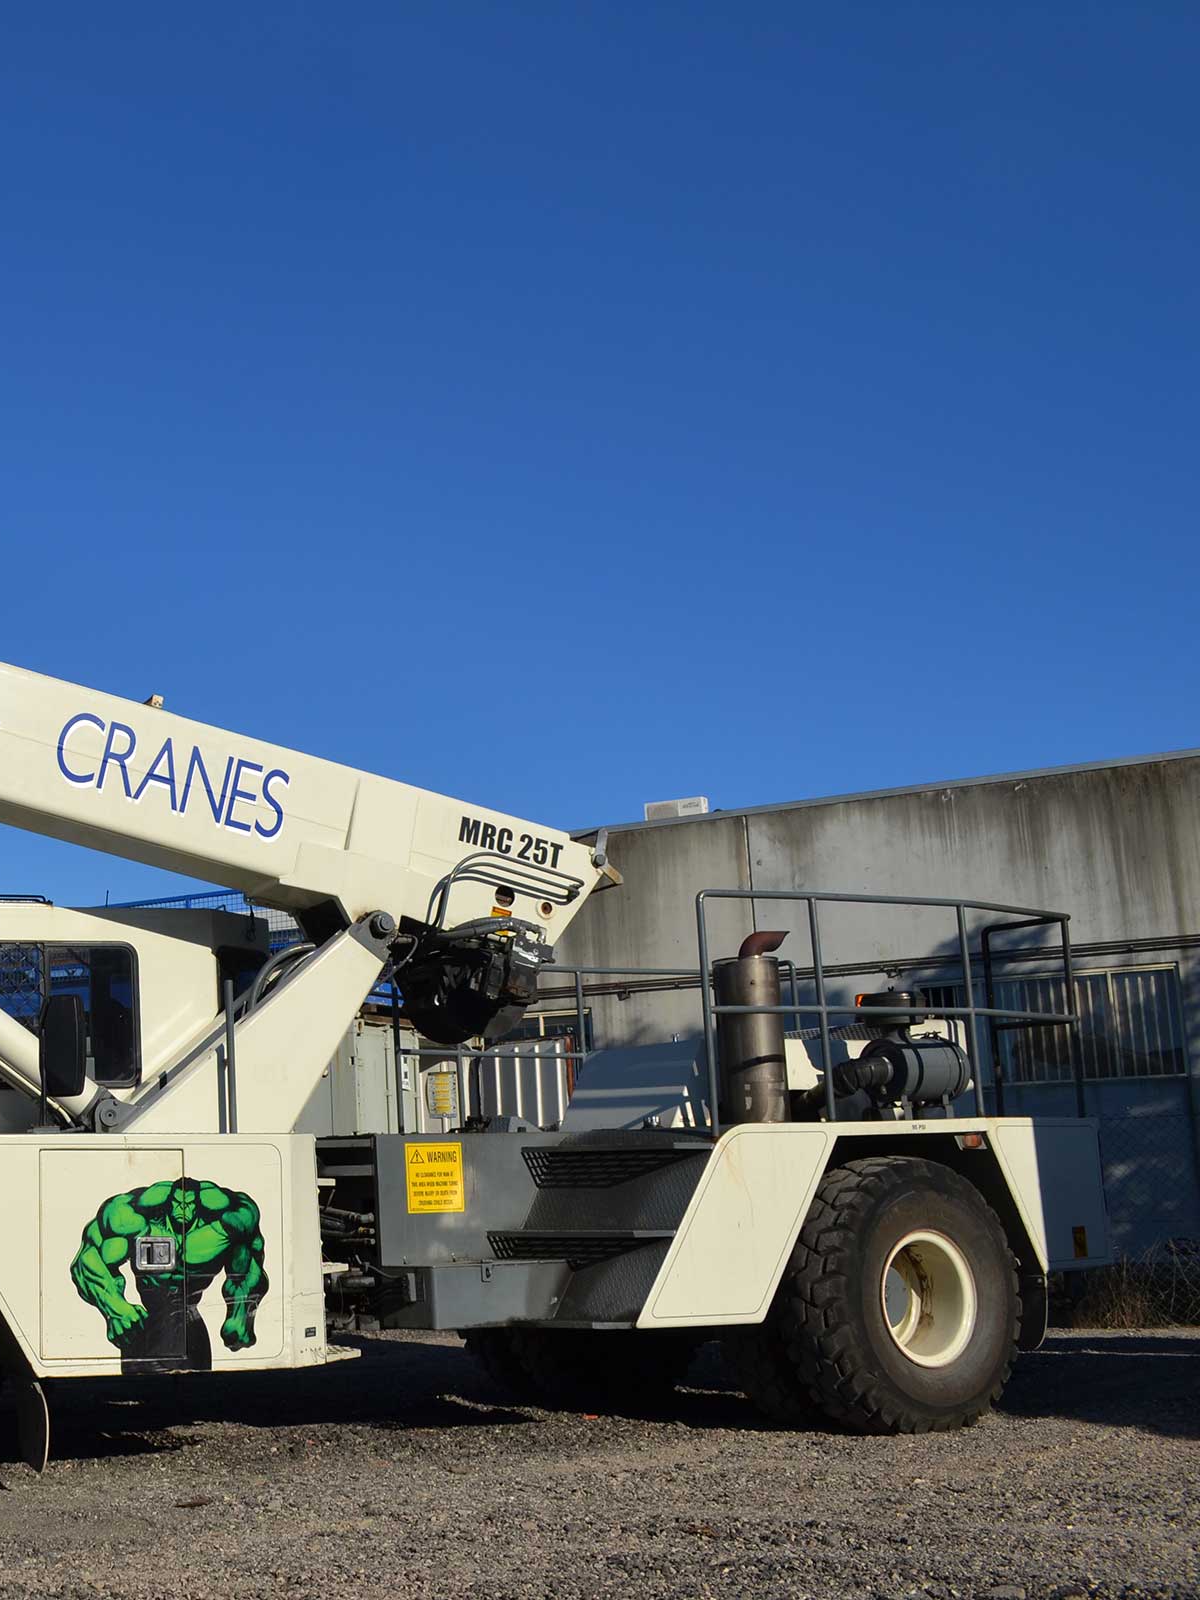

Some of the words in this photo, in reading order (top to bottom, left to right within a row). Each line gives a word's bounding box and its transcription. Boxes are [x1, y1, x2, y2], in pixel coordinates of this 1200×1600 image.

[57, 713, 290, 838] CRANES
[458, 816, 514, 855] MRC
[517, 834, 564, 869] 25T
[426, 1151, 457, 1163] WARNING
